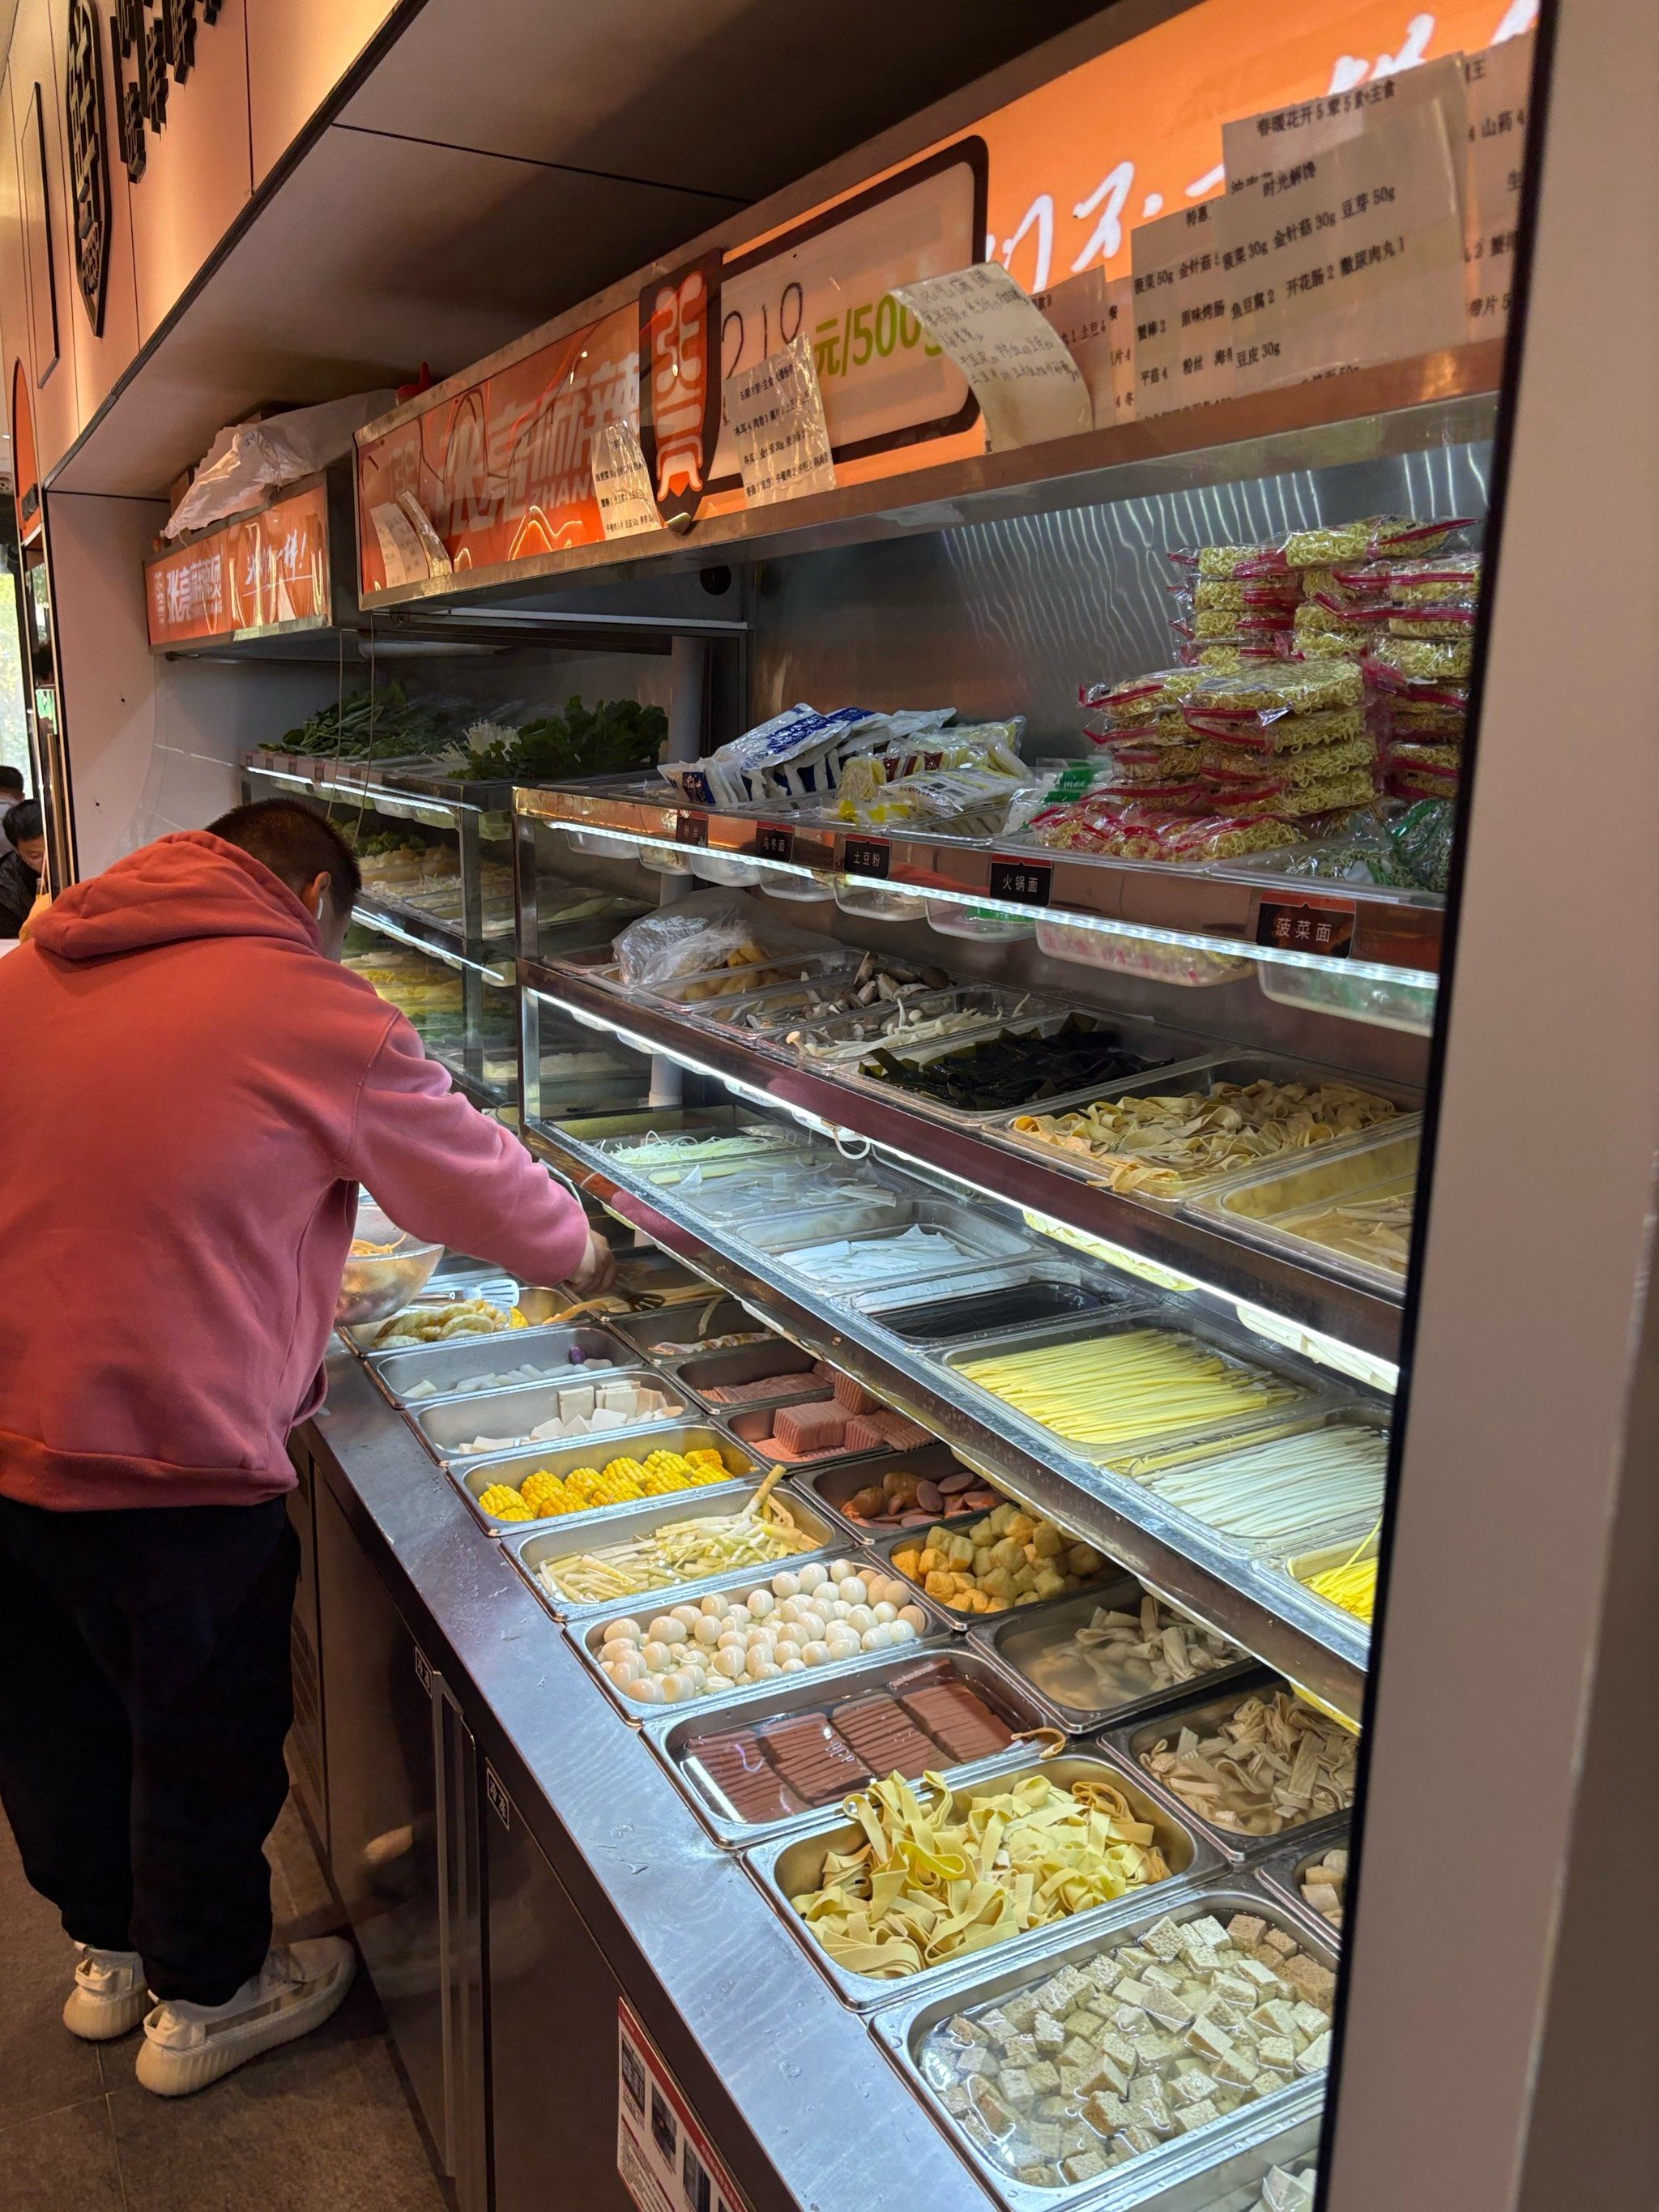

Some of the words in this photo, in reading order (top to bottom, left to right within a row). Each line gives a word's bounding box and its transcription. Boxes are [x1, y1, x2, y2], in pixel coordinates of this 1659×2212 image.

[813, 293, 944, 378] 元/500
[531, 472, 599, 508] ZHAN
[853, 852, 881, 869] 土豆粉
[1002, 875, 1039, 893] 火锅面
[1275, 916, 1333, 944] 菠菜面
